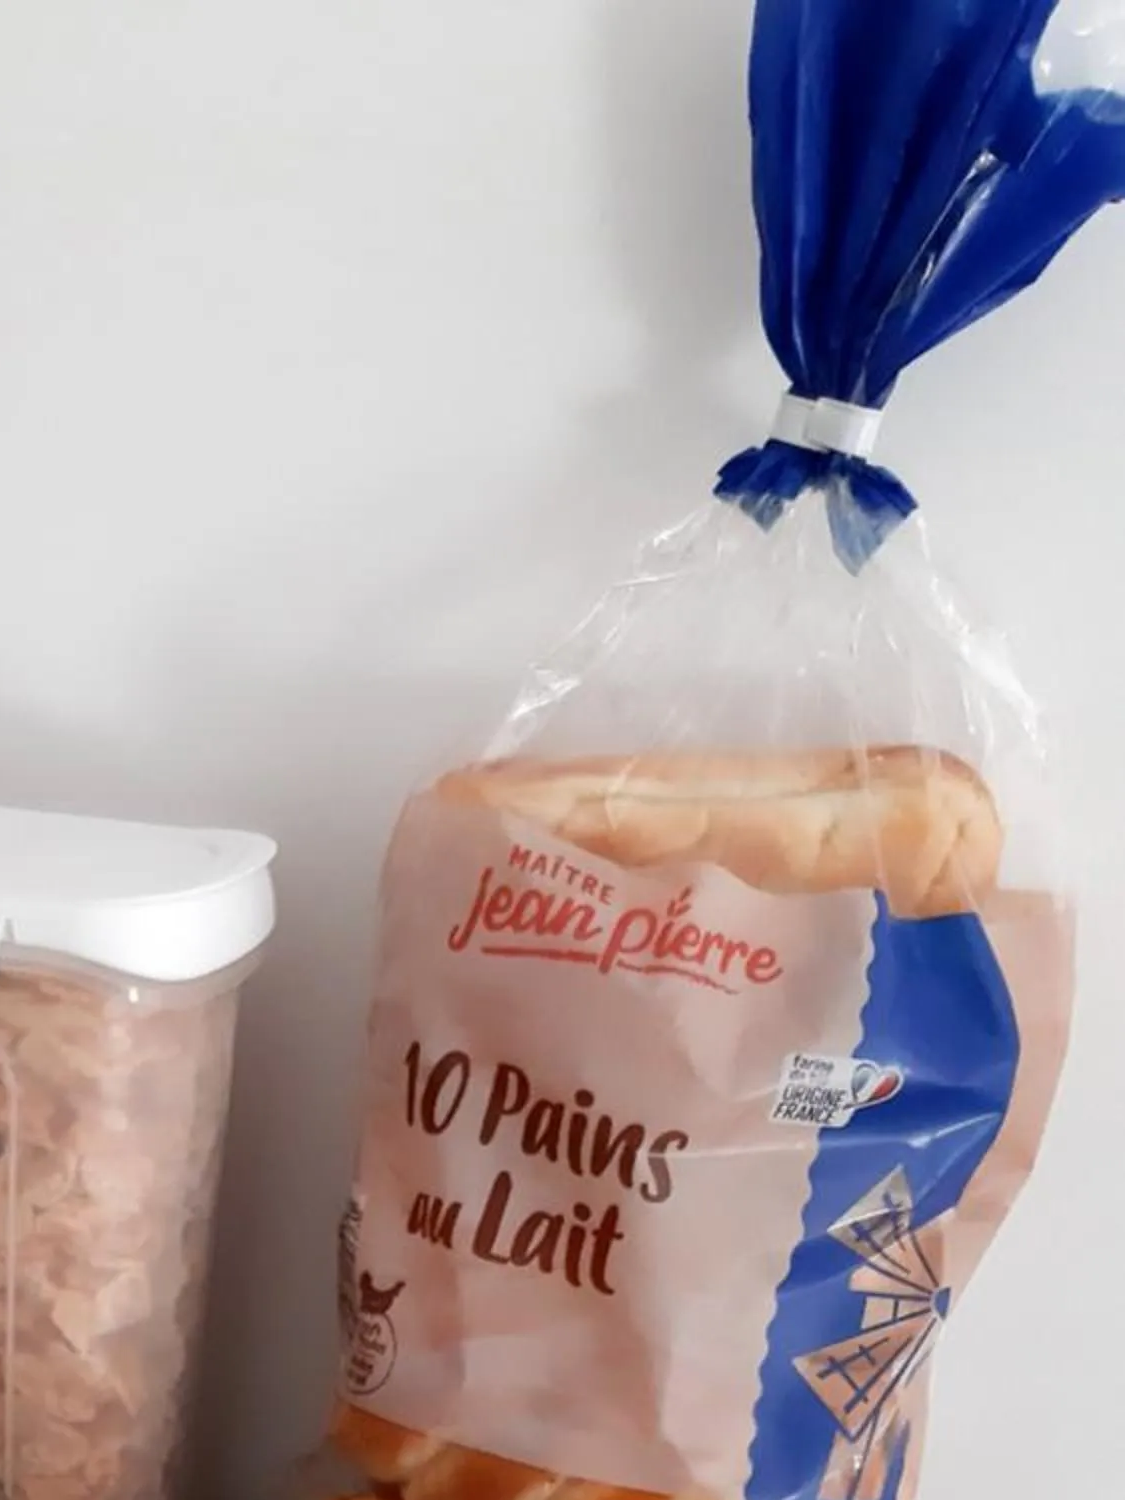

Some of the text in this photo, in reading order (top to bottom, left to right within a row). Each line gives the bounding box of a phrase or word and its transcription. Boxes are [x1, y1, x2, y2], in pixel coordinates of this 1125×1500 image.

[508, 845, 614, 905] MAÎTRE
[405, 1040, 689, 1203] 10 Pains
[407, 1170, 624, 1295] au Lait
